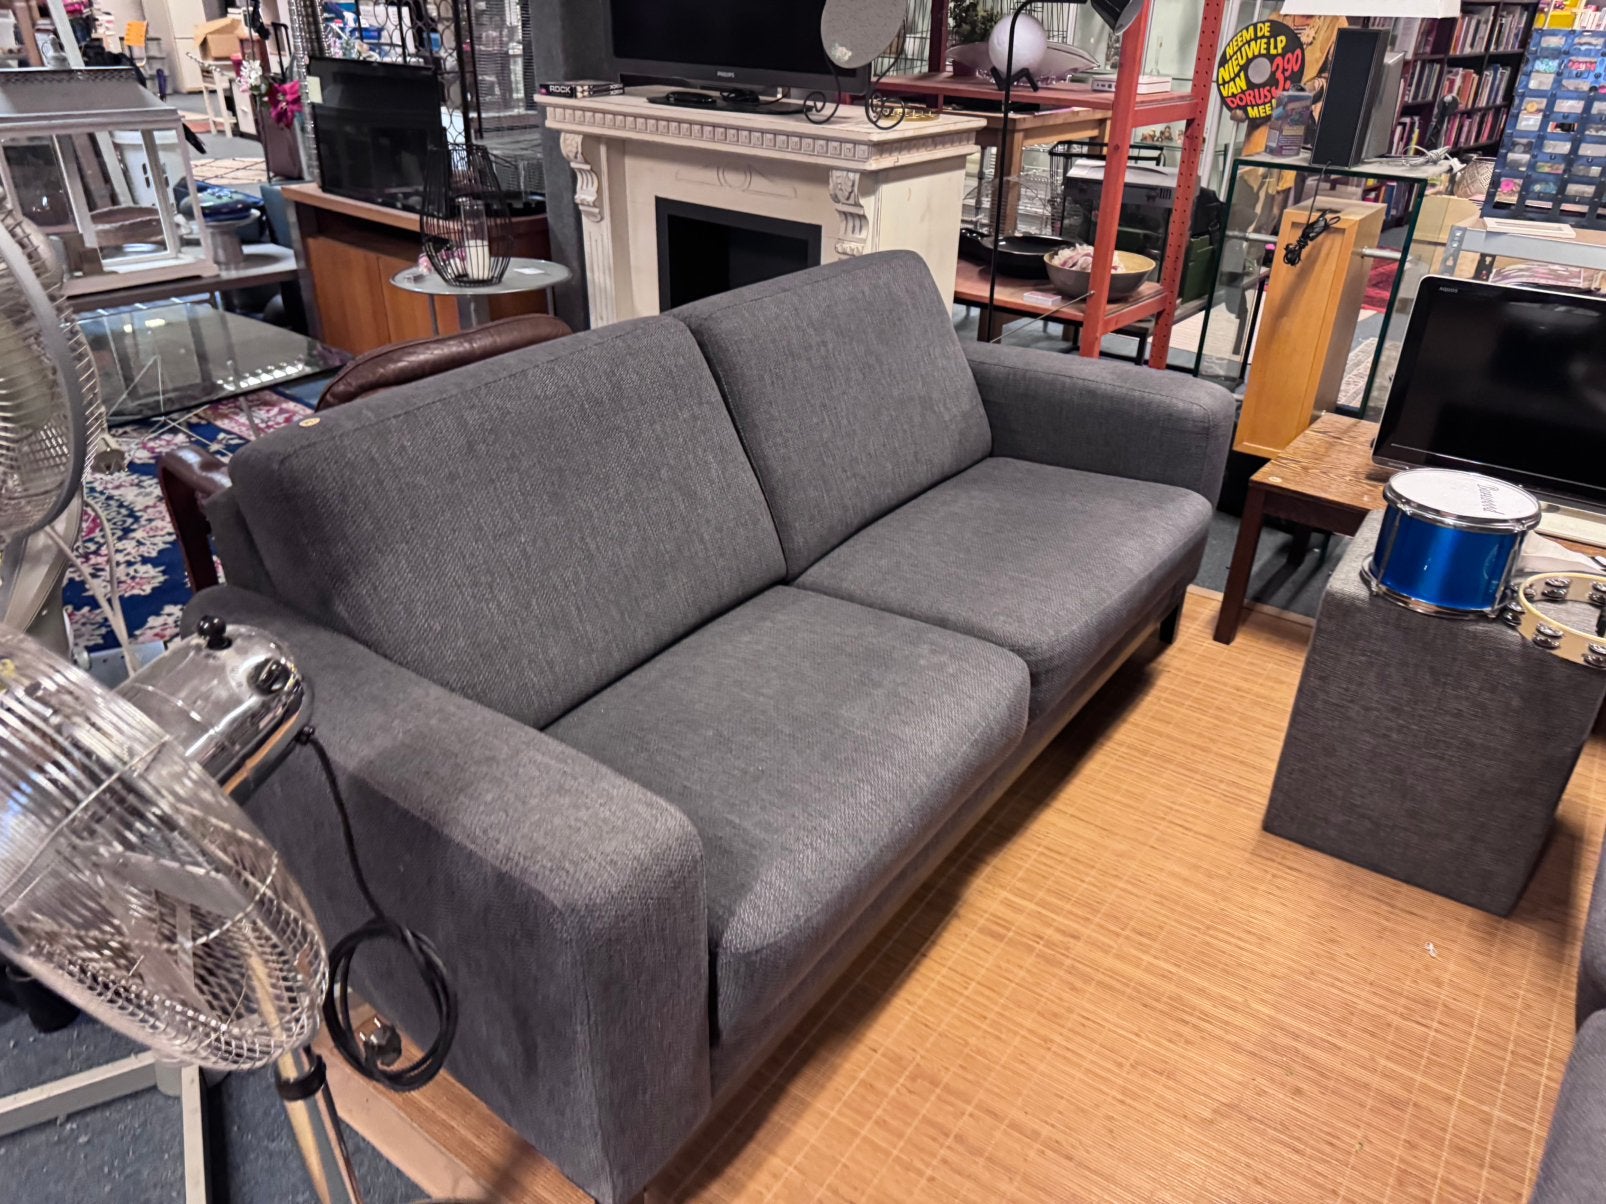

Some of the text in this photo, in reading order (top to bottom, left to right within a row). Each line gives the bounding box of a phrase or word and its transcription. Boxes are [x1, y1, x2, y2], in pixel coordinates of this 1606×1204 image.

[1226, 22, 1270, 59] NEEM DE
[1218, 35, 1287, 84] NIEUWE LP
[549, 85, 571, 93] ROCK
[1219, 70, 1247, 97] VAN
[1225, 86, 1271, 108] DORUS
